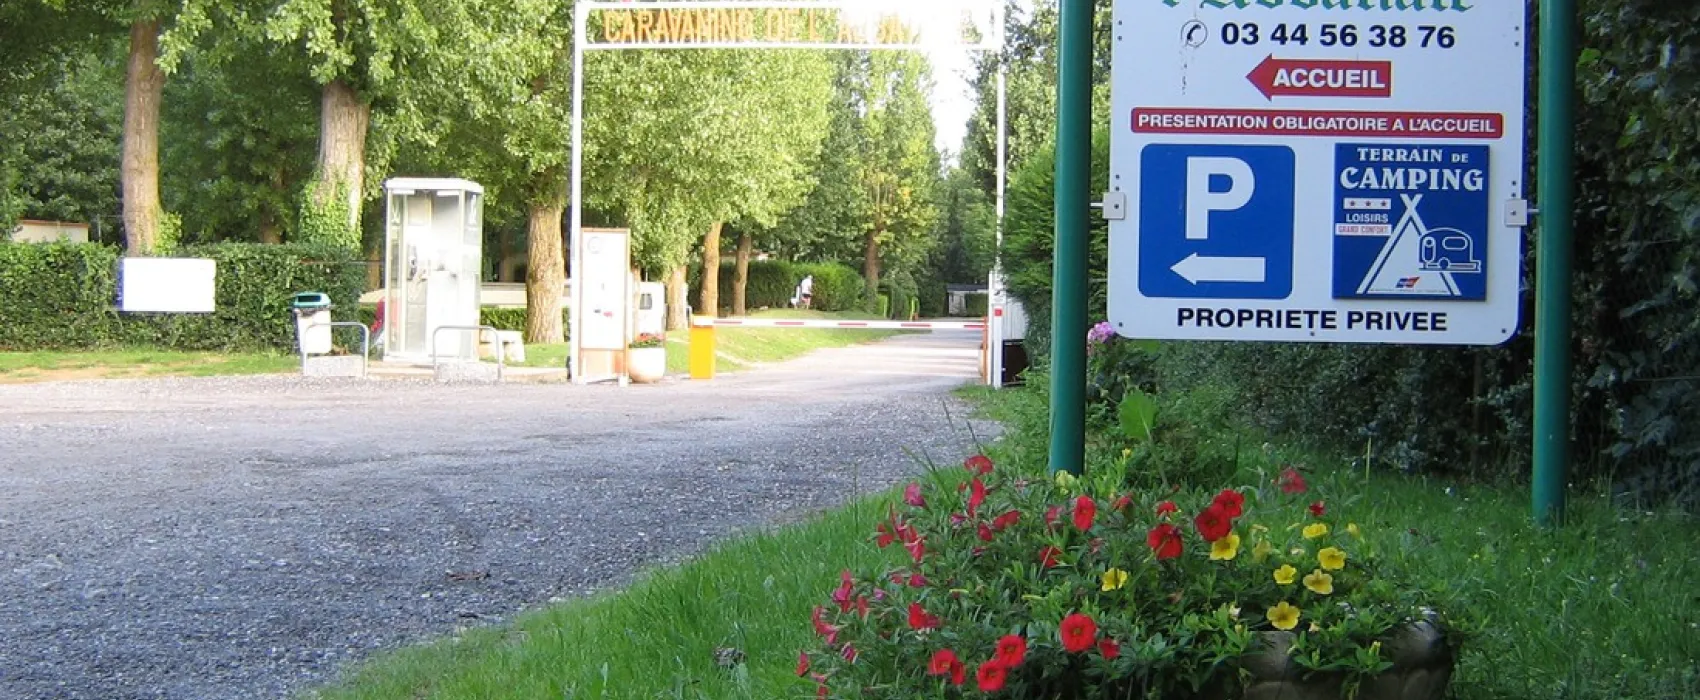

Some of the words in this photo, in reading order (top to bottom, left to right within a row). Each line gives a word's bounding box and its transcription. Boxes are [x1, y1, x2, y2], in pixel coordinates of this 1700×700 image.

[1220, 22, 1259, 45] 03
[1270, 23, 1308, 45] 44
[1319, 23, 1358, 46] 56
[1368, 25, 1406, 47] 38
[1417, 25, 1455, 48] 76
[1272, 67, 1385, 89] ACCUEIL
[1138, 114, 1268, 130] PRESENTATION
[1275, 117, 1387, 131] OBLIGATOIRE
[1393, 119, 1404, 131] A
[1409, 119, 1496, 133] L'ACCUEIL
[1357, 148, 1442, 162] TERRAIN
[1451, 153, 1468, 163] DE
[1340, 167, 1483, 191] CAMPING
[1186, 156, 1255, 239] P
[1338, 225, 1359, 233] GRAND
[1346, 214, 1388, 223] LOISIRS
[1177, 308, 1337, 330] PROPRIETE
[1347, 311, 1447, 331] PRIVEE
